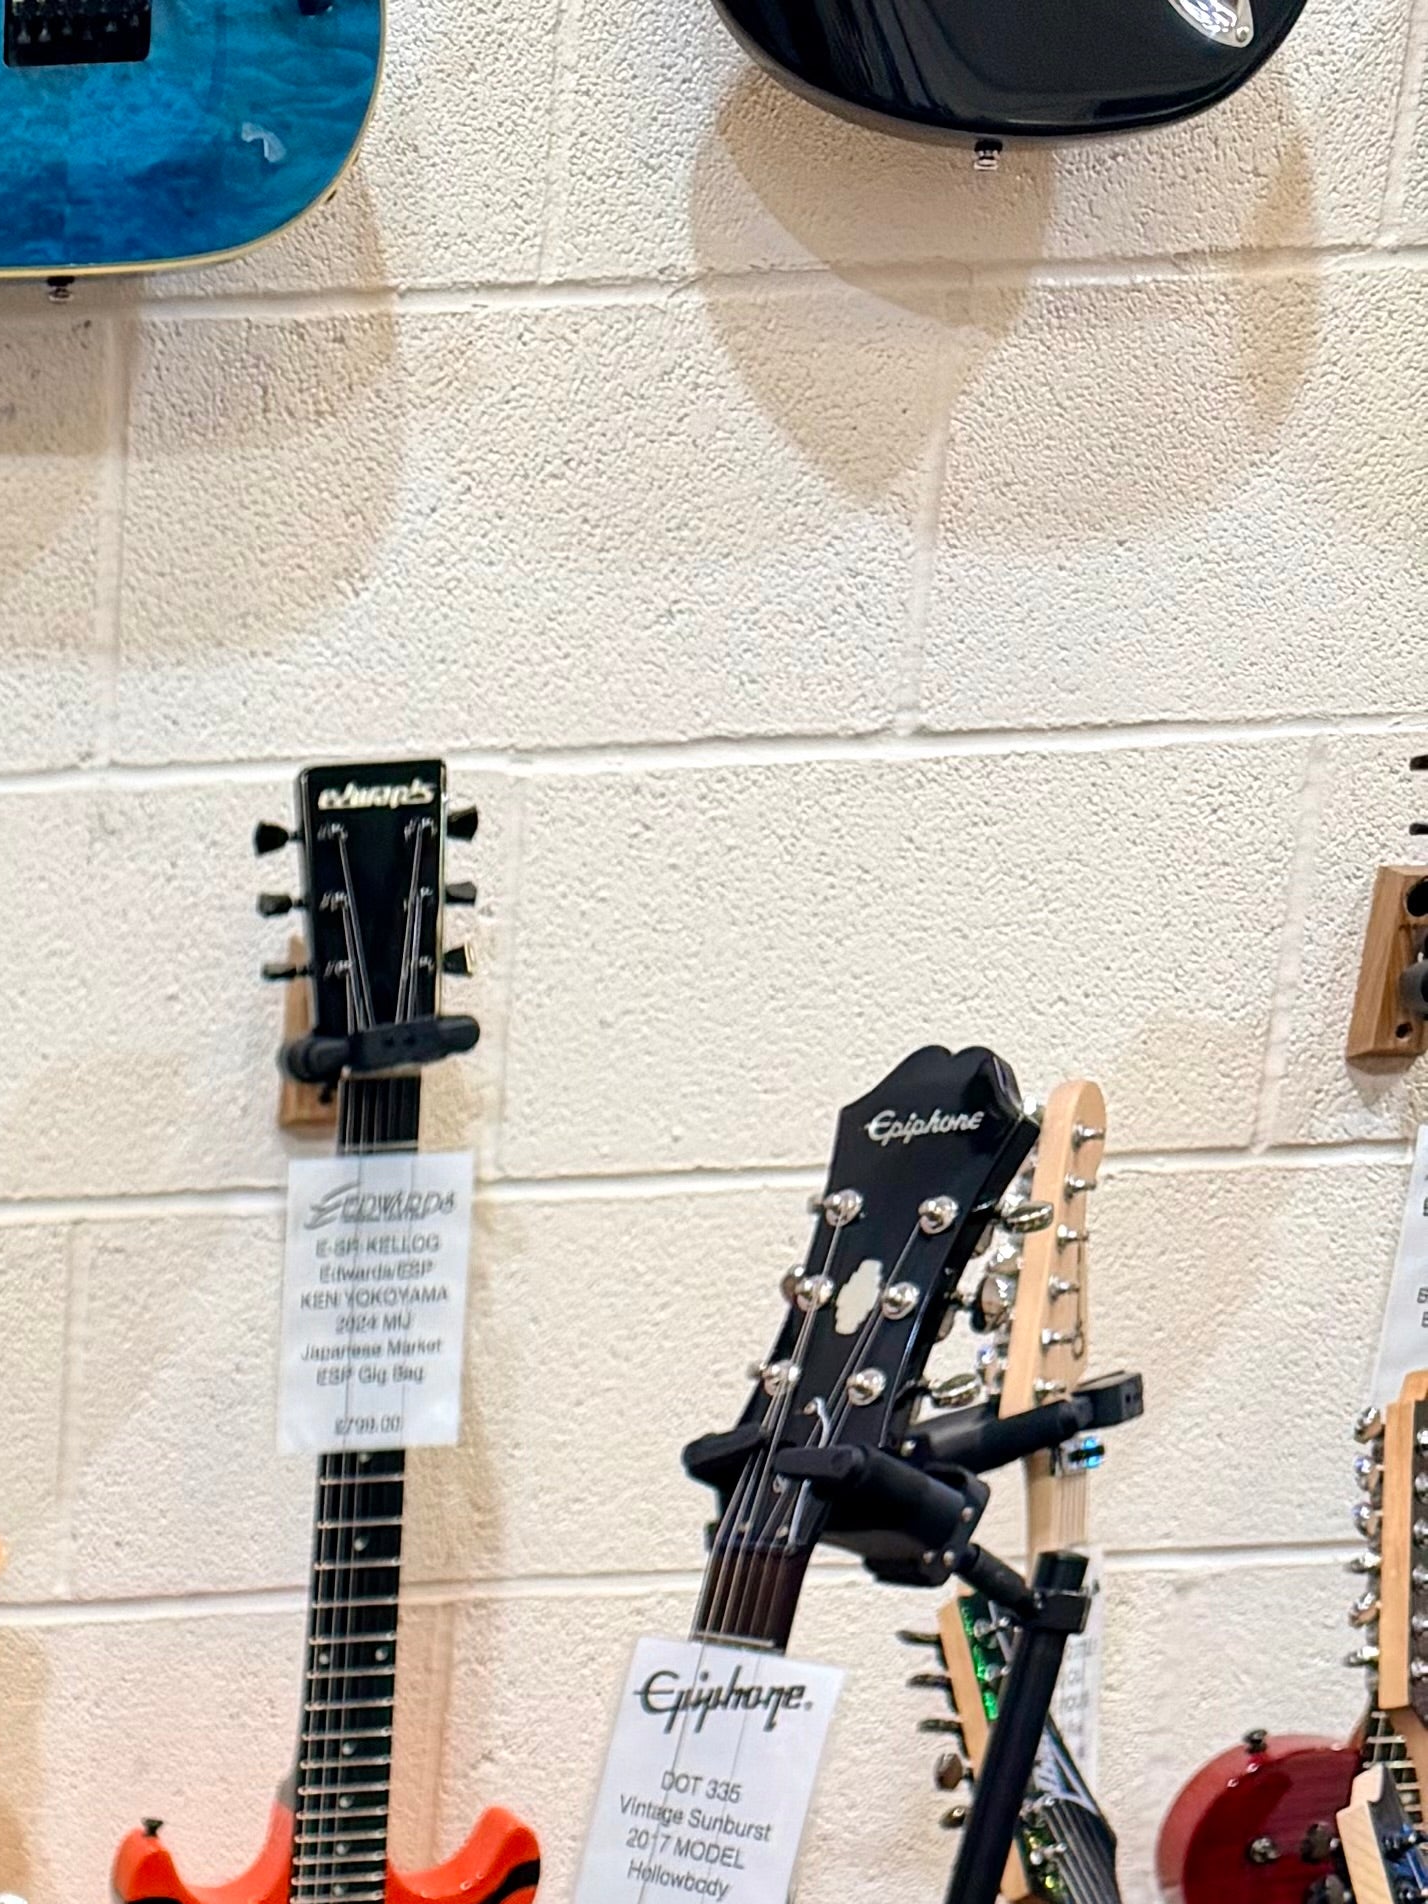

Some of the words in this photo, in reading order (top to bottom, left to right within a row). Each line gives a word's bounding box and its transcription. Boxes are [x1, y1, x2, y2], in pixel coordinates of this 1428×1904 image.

[864, 1108, 986, 1147] Epiphone
[300, 1292, 338, 1310] KEN
[344, 1286, 448, 1308] YOKOYAMA
[301, 1343, 382, 1363] Japanese
[387, 1338, 444, 1357] Market
[358, 1367, 387, 1388] Gig
[632, 1665, 810, 1734] Epiphone
[661, 1770, 702, 1796] DOT
[705, 1778, 742, 1804] 335
[619, 1794, 684, 1827] Vintage
[687, 1807, 772, 1842] Sunburst
[626, 1828, 671, 1854] 2017
[672, 1839, 746, 1870] MODEL
[626, 1860, 731, 1901] Hollowbody
